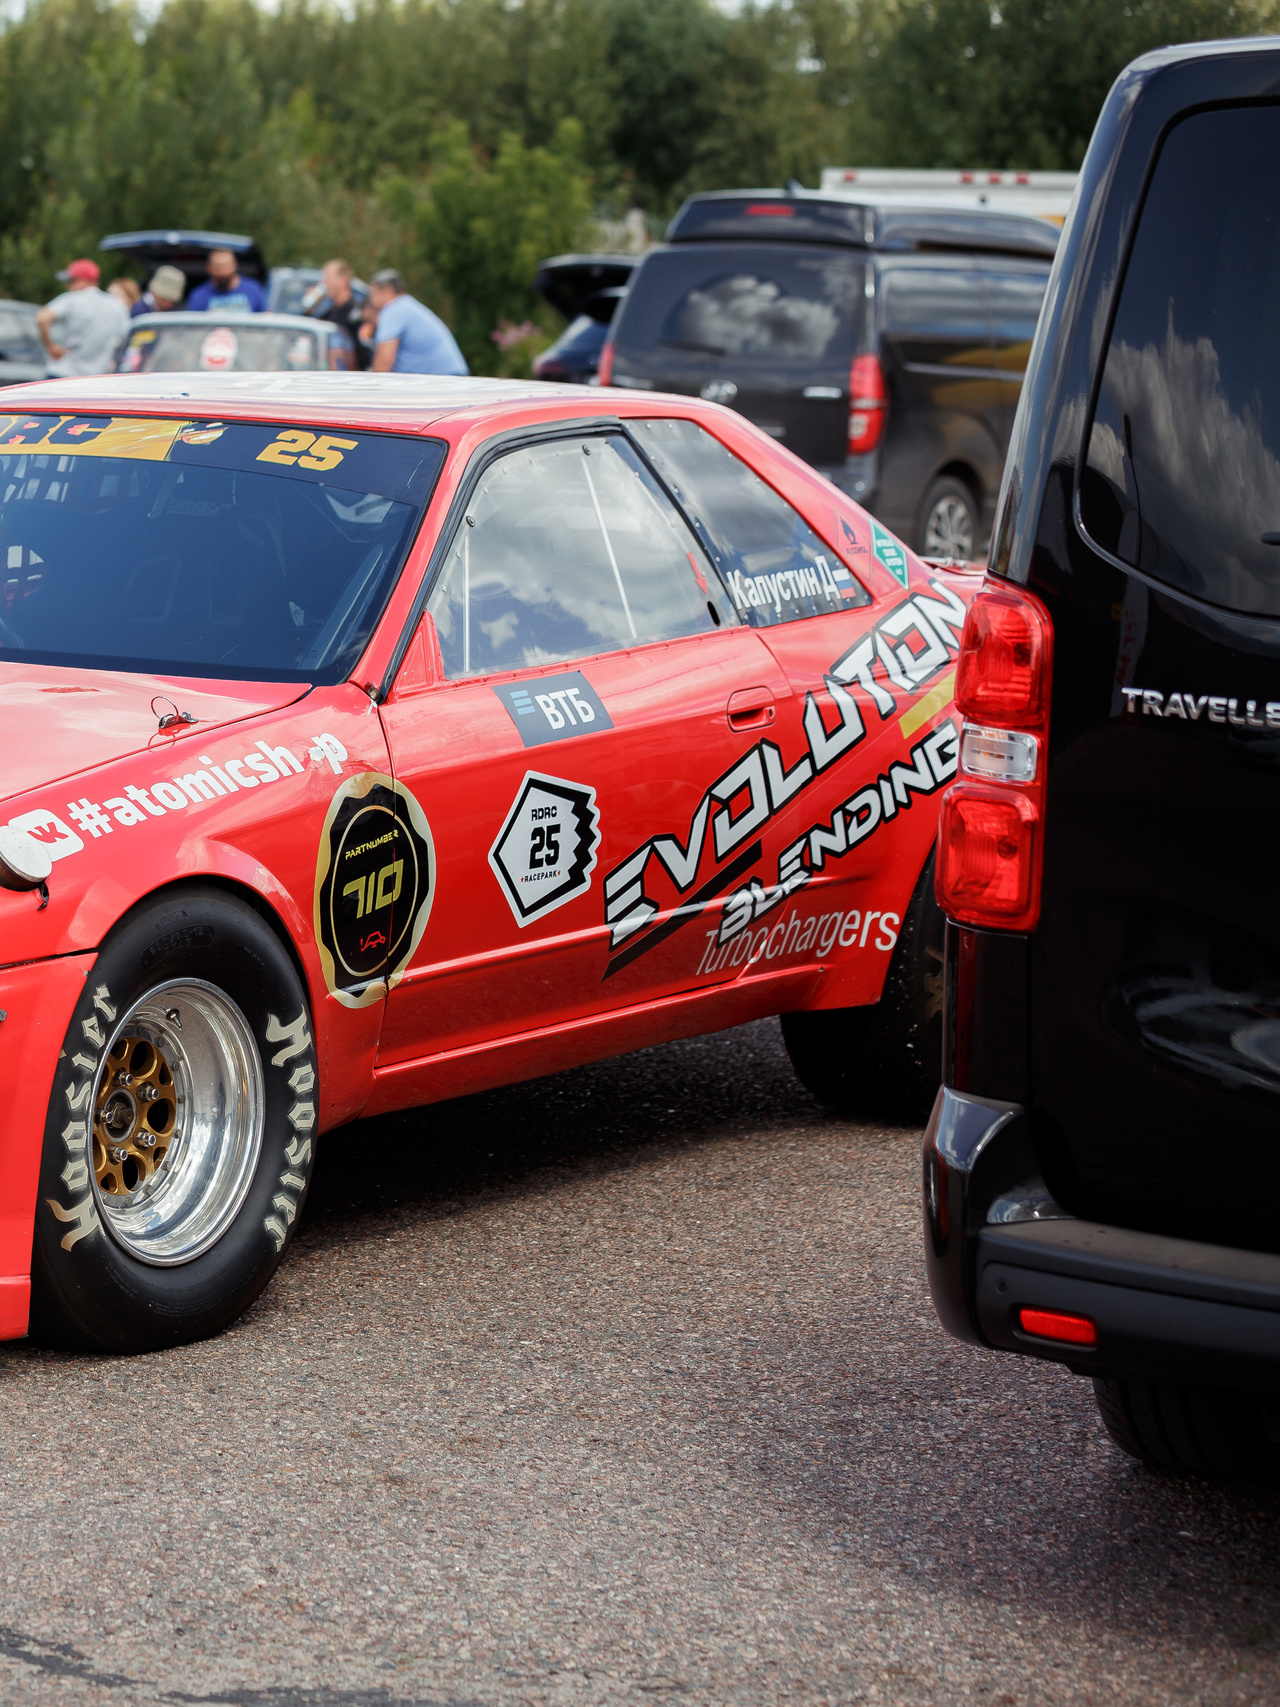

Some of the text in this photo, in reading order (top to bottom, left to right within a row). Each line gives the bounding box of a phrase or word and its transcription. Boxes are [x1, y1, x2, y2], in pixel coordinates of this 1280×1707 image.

[255, 429, 359, 472] 25
[726, 565, 823, 613] Капустин
[534, 687, 596, 730] ВТБ
[66, 733, 349, 838] #atomicshp
[603, 577, 967, 951] EVOLUTION
[530, 805, 558, 822] RDRC
[716, 718, 961, 948] BLENDING
[345, 829, 400, 861] PARTNUMBER
[529, 823, 561, 870] 25
[524, 869, 558, 883] RACEPARK
[695, 909, 900, 976] Turbochargers
[46, 985, 118, 1252] Hoosier
